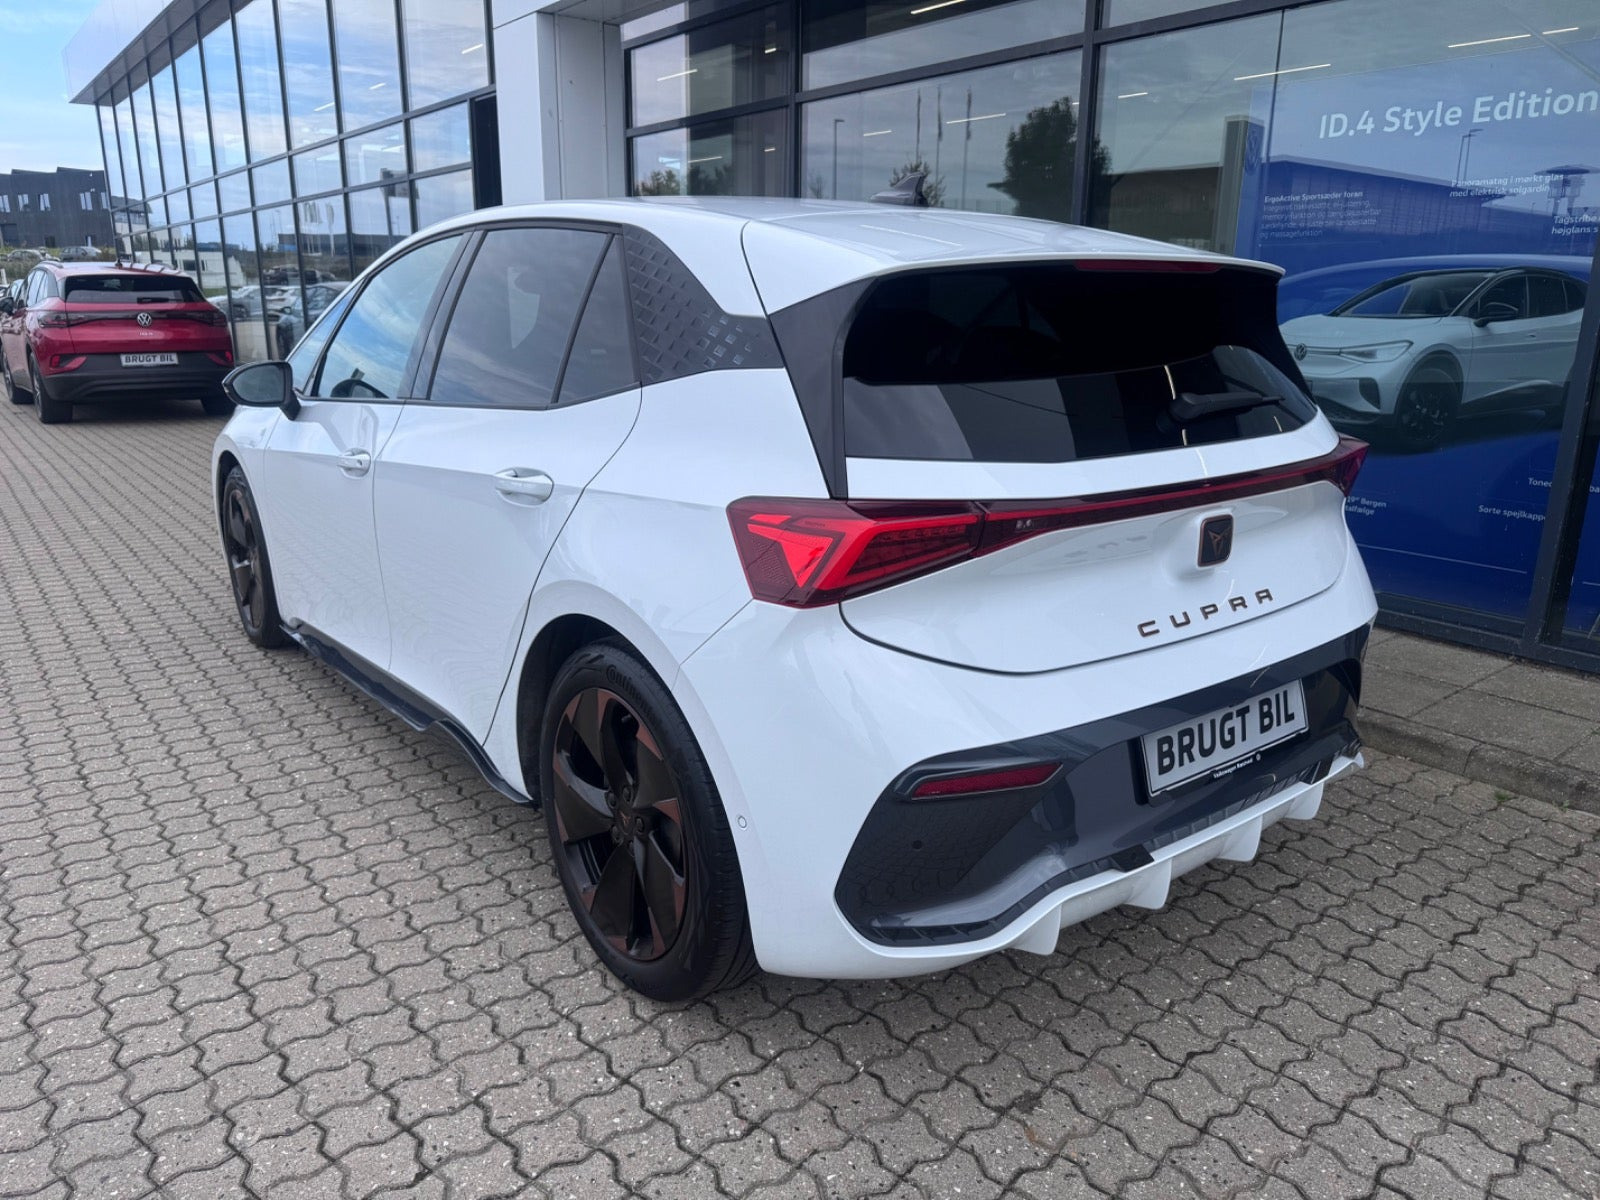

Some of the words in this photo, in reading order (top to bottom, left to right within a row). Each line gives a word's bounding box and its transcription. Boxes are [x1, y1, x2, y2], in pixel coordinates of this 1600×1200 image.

[1319, 110, 1375, 139] ID.4
[1383, 101, 1463, 136] Style
[1472, 88, 1599, 124] Edition
[1449, 187, 1469, 198] med
[1470, 184, 1506, 197] elektrisk
[1553, 213, 1600, 225] Tagstribe
[124, 354, 158, 363] BRUGT
[159, 354, 175, 362] BIL
[1478, 504, 1502, 515] Sorte
[1137, 588, 1274, 638] CUPRA
[1156, 704, 1250, 776] BRUGT
[1258, 689, 1295, 735] BIL
